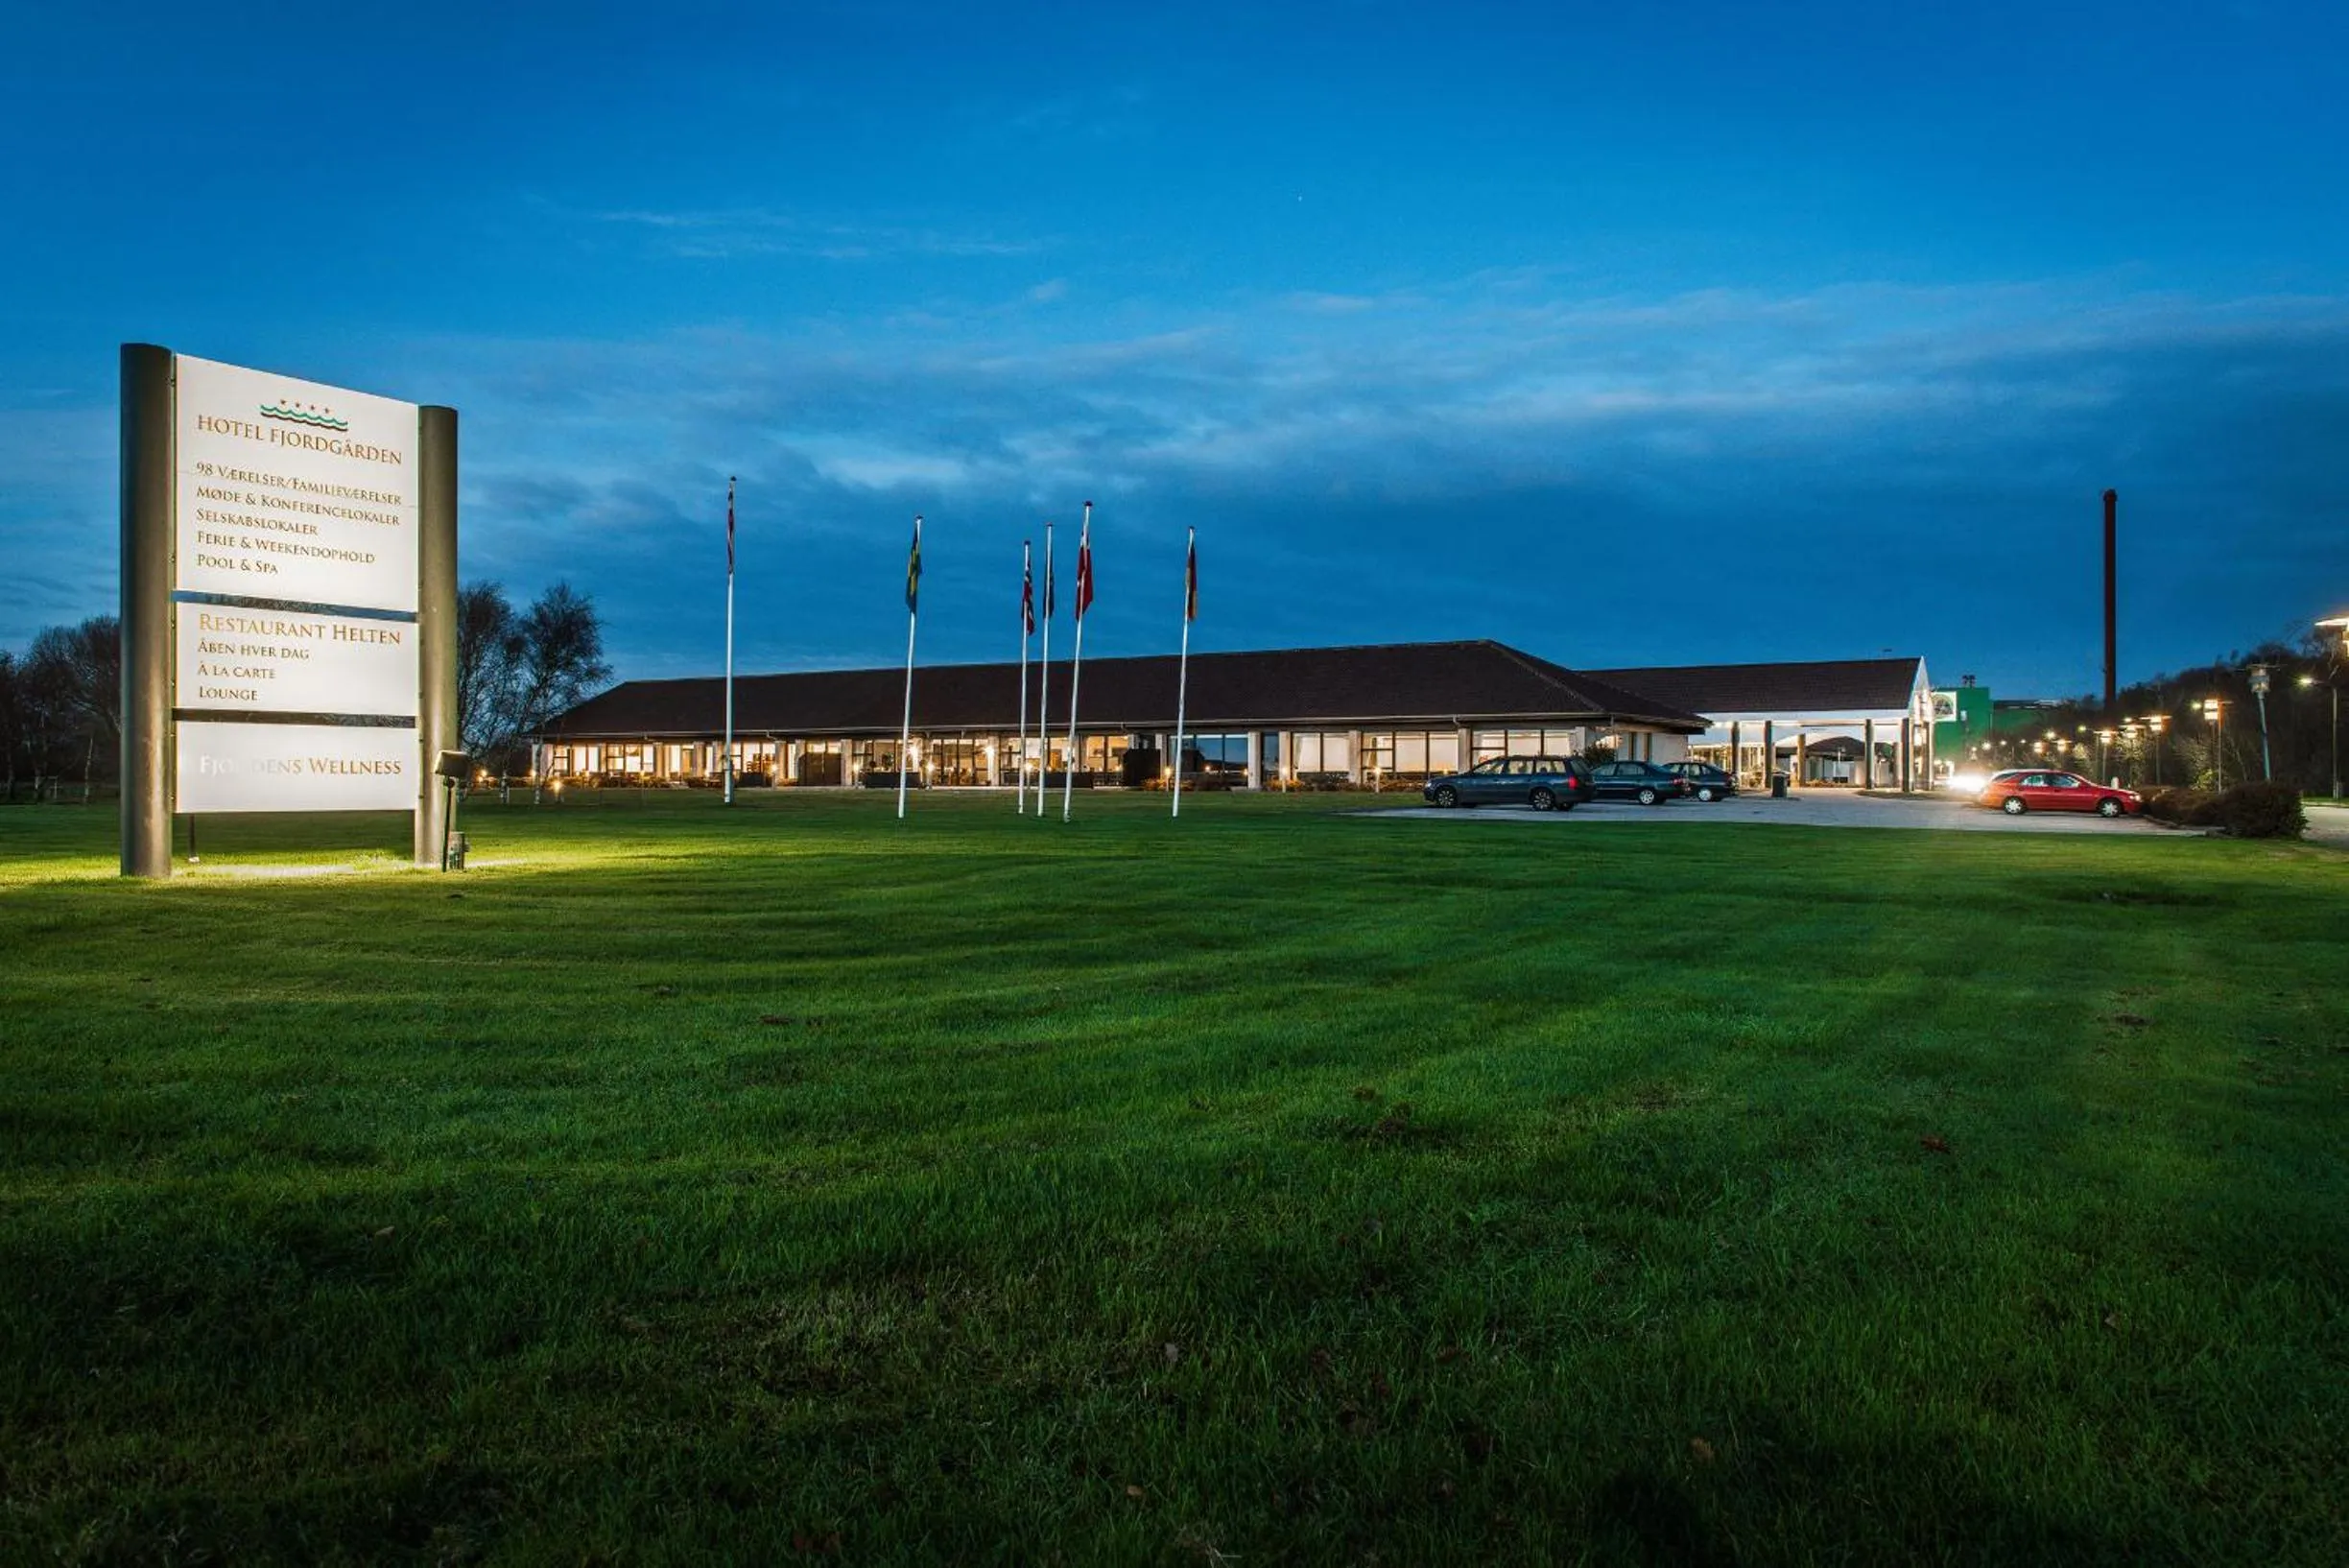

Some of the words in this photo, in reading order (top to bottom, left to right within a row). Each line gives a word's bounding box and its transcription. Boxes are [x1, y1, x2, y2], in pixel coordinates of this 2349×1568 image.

[198, 415, 264, 440] HOTEL
[271, 428, 402, 465] FJORDGÅRDEN
[197, 462, 213, 476] 98
[197, 486, 241, 504] MØDE
[246, 492, 256, 506] &
[261, 494, 400, 525] KONFERENCELOKALER
[197, 509, 319, 535] SELSKABSLOKALER
[198, 531, 236, 547] FERIE
[241, 536, 251, 549] &
[255, 538, 375, 564] WEEKENDOPHOLD
[198, 554, 236, 570] POOL
[241, 559, 251, 571] &
[256, 560, 278, 575] SPA
[199, 613, 326, 640] RESTAURANT
[332, 625, 401, 645] HELTEN
[241, 645, 276, 658] HVER
[281, 648, 310, 659] DAG
[213, 665, 229, 677] LA
[233, 666, 276, 679] CARTE
[199, 686, 258, 701] LOUNGE
[200, 755, 301, 776] FJODENS
[309, 758, 401, 774] WELLNESS
